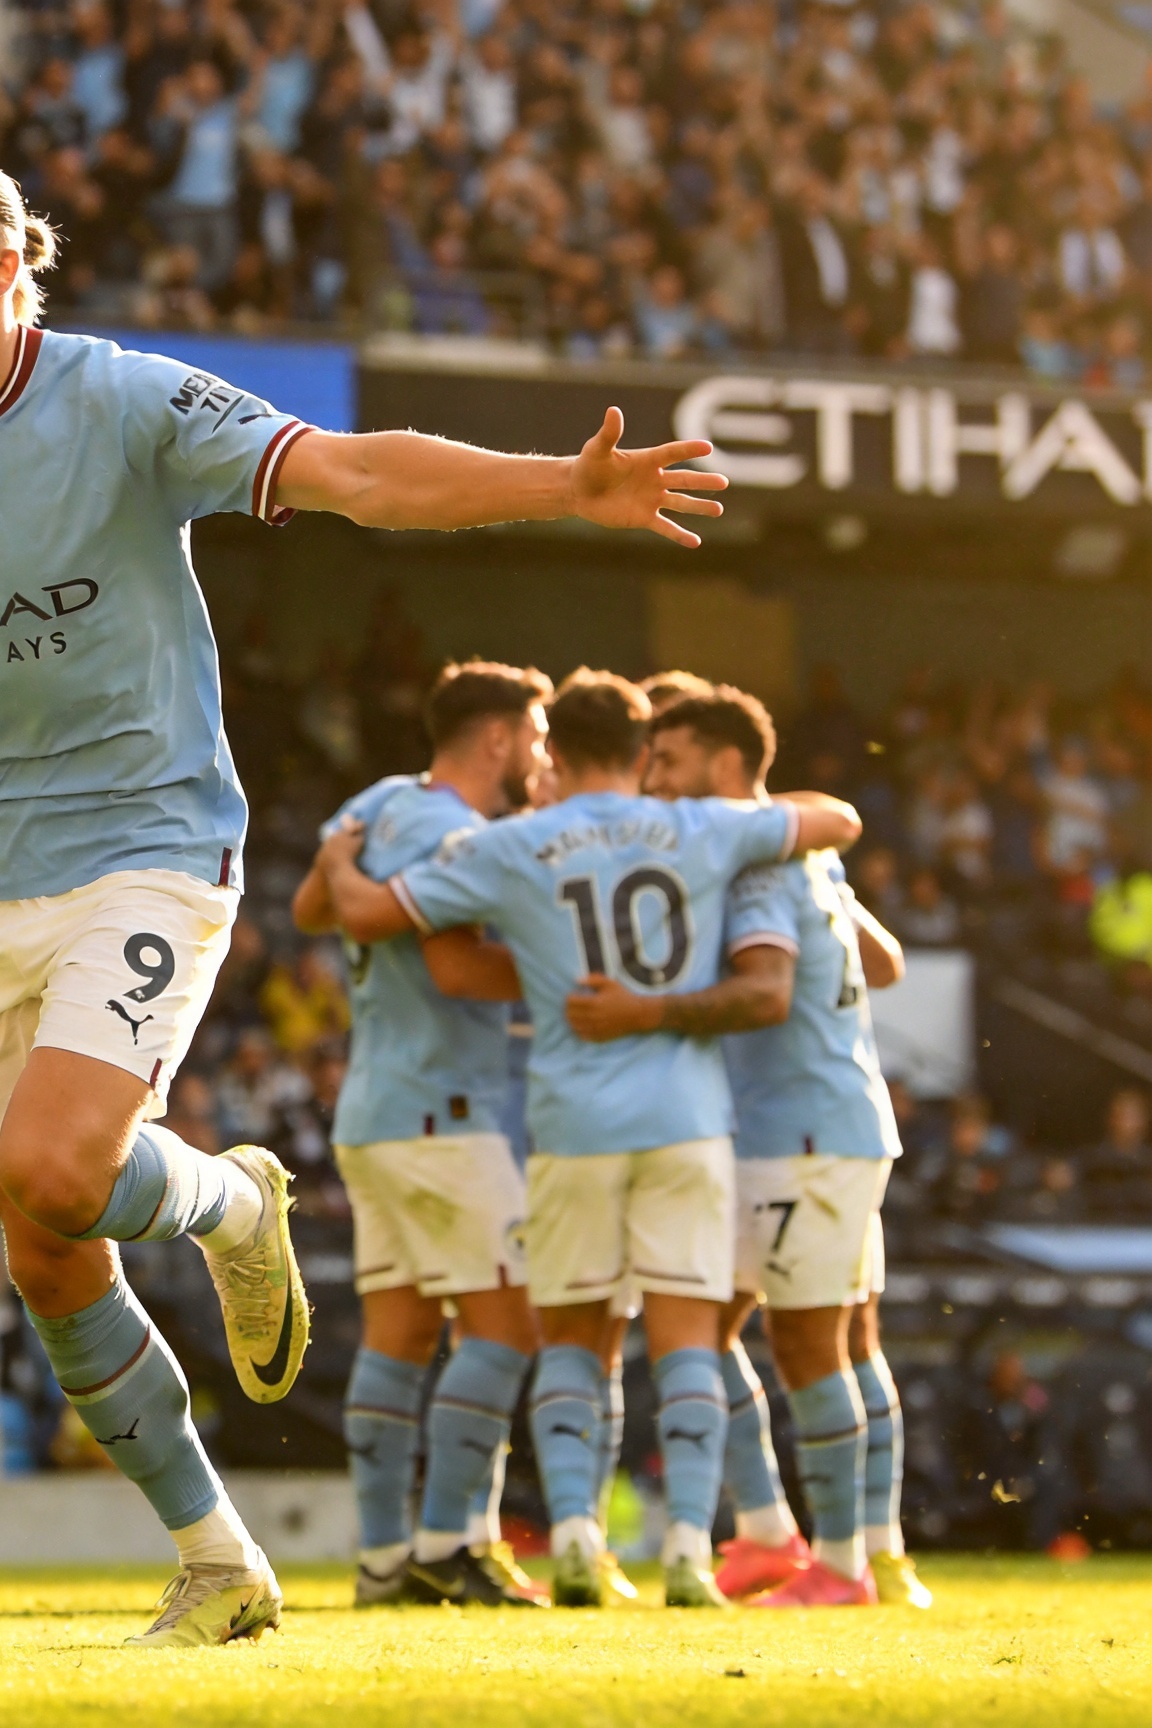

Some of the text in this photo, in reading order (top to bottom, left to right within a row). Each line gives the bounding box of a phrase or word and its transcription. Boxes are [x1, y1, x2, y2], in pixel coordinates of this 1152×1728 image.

[674, 375, 1152, 505] ETIHA
[121, 931, 176, 1004] 9
[560, 865, 693, 990] 10
[753, 1200, 799, 1253] 7
